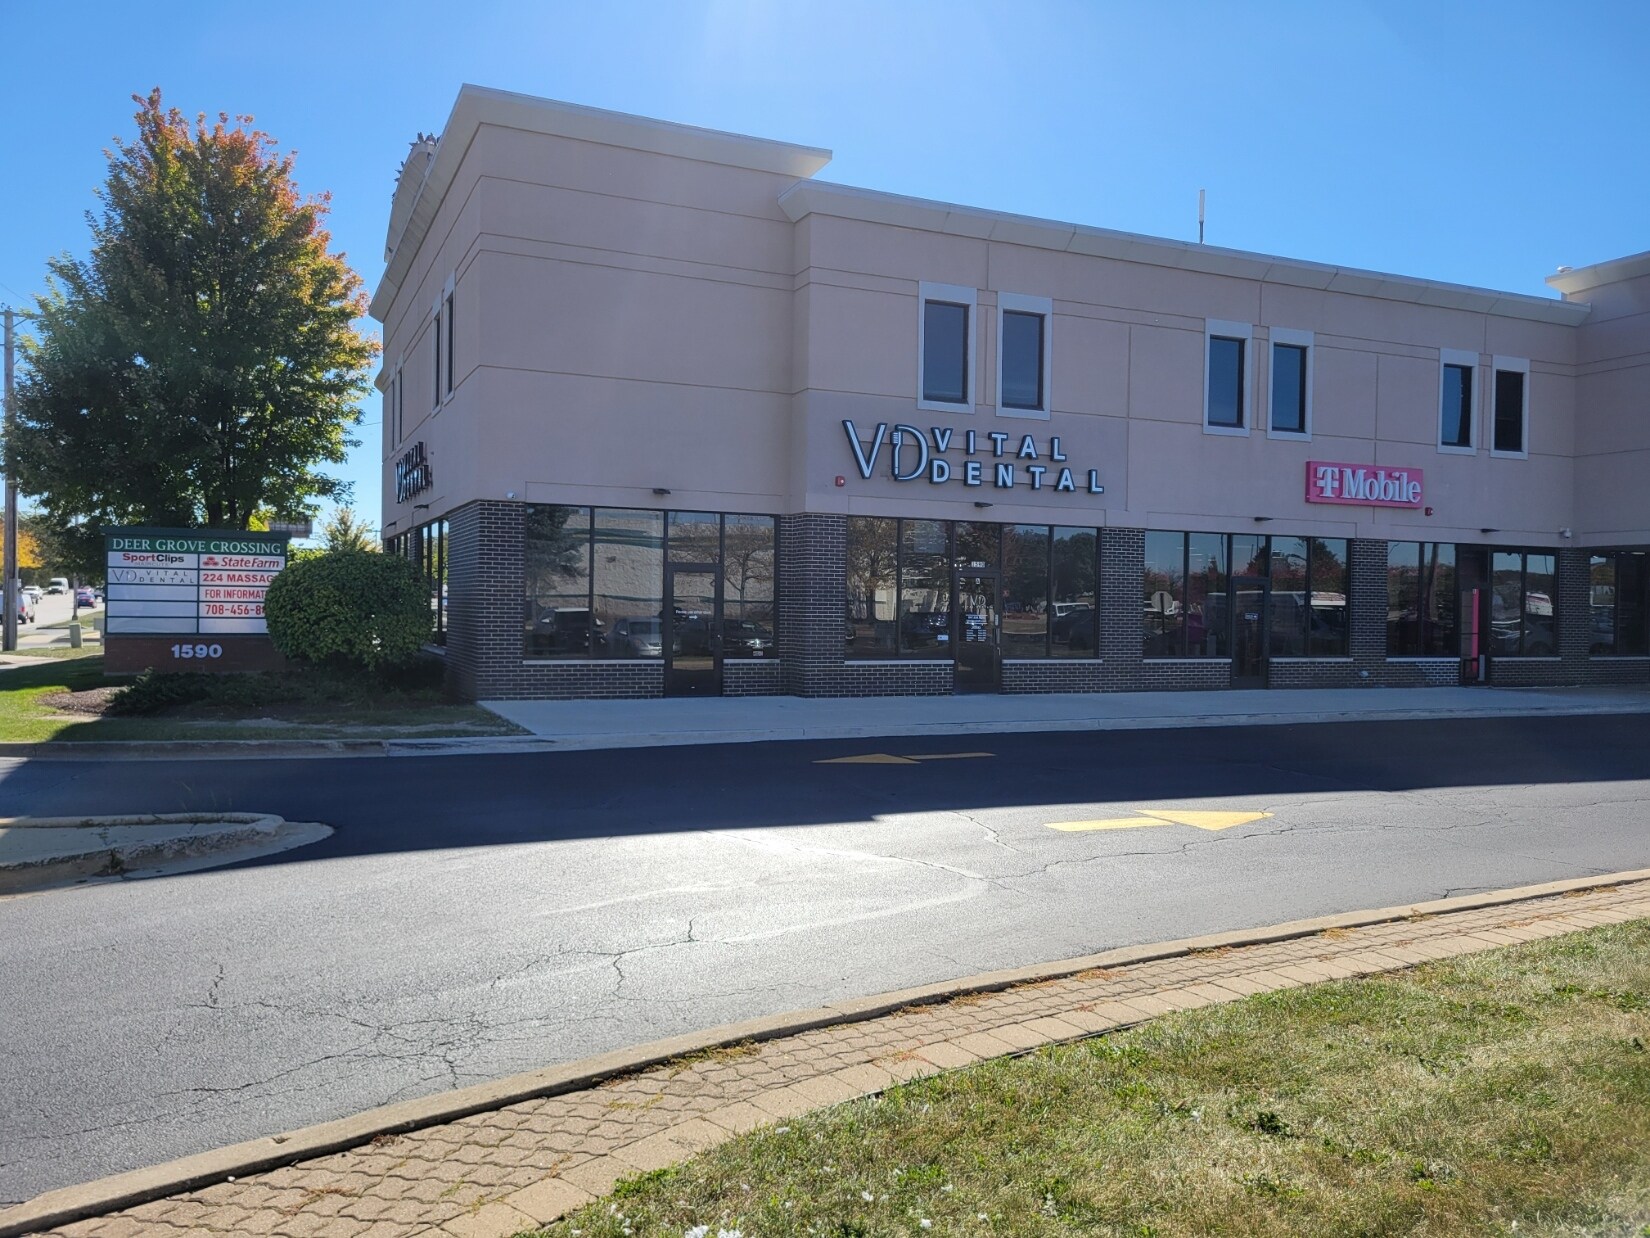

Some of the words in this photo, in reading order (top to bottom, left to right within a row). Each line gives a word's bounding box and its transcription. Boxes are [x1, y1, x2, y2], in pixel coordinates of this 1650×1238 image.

[842, 419, 930, 481] VD
[930, 426, 1067, 462] VITAL
[929, 458, 1105, 494] DENTAL
[1316, 466, 1339, 497] T
[1340, 467, 1421, 503] Mobile
[113, 538, 151, 550] DEER
[155, 539, 206, 552] GROVE
[210, 541, 281, 554] CROSSING
[139, 576, 195, 584] DENTAL
[202, 573, 224, 583] 224
[226, 573, 274, 583] MASSAG
[204, 589, 222, 599] FOR
[223, 589, 266, 599] INFORMAT
[205, 604, 266, 616] 708-456-8
[171, 643, 223, 659] 1590
